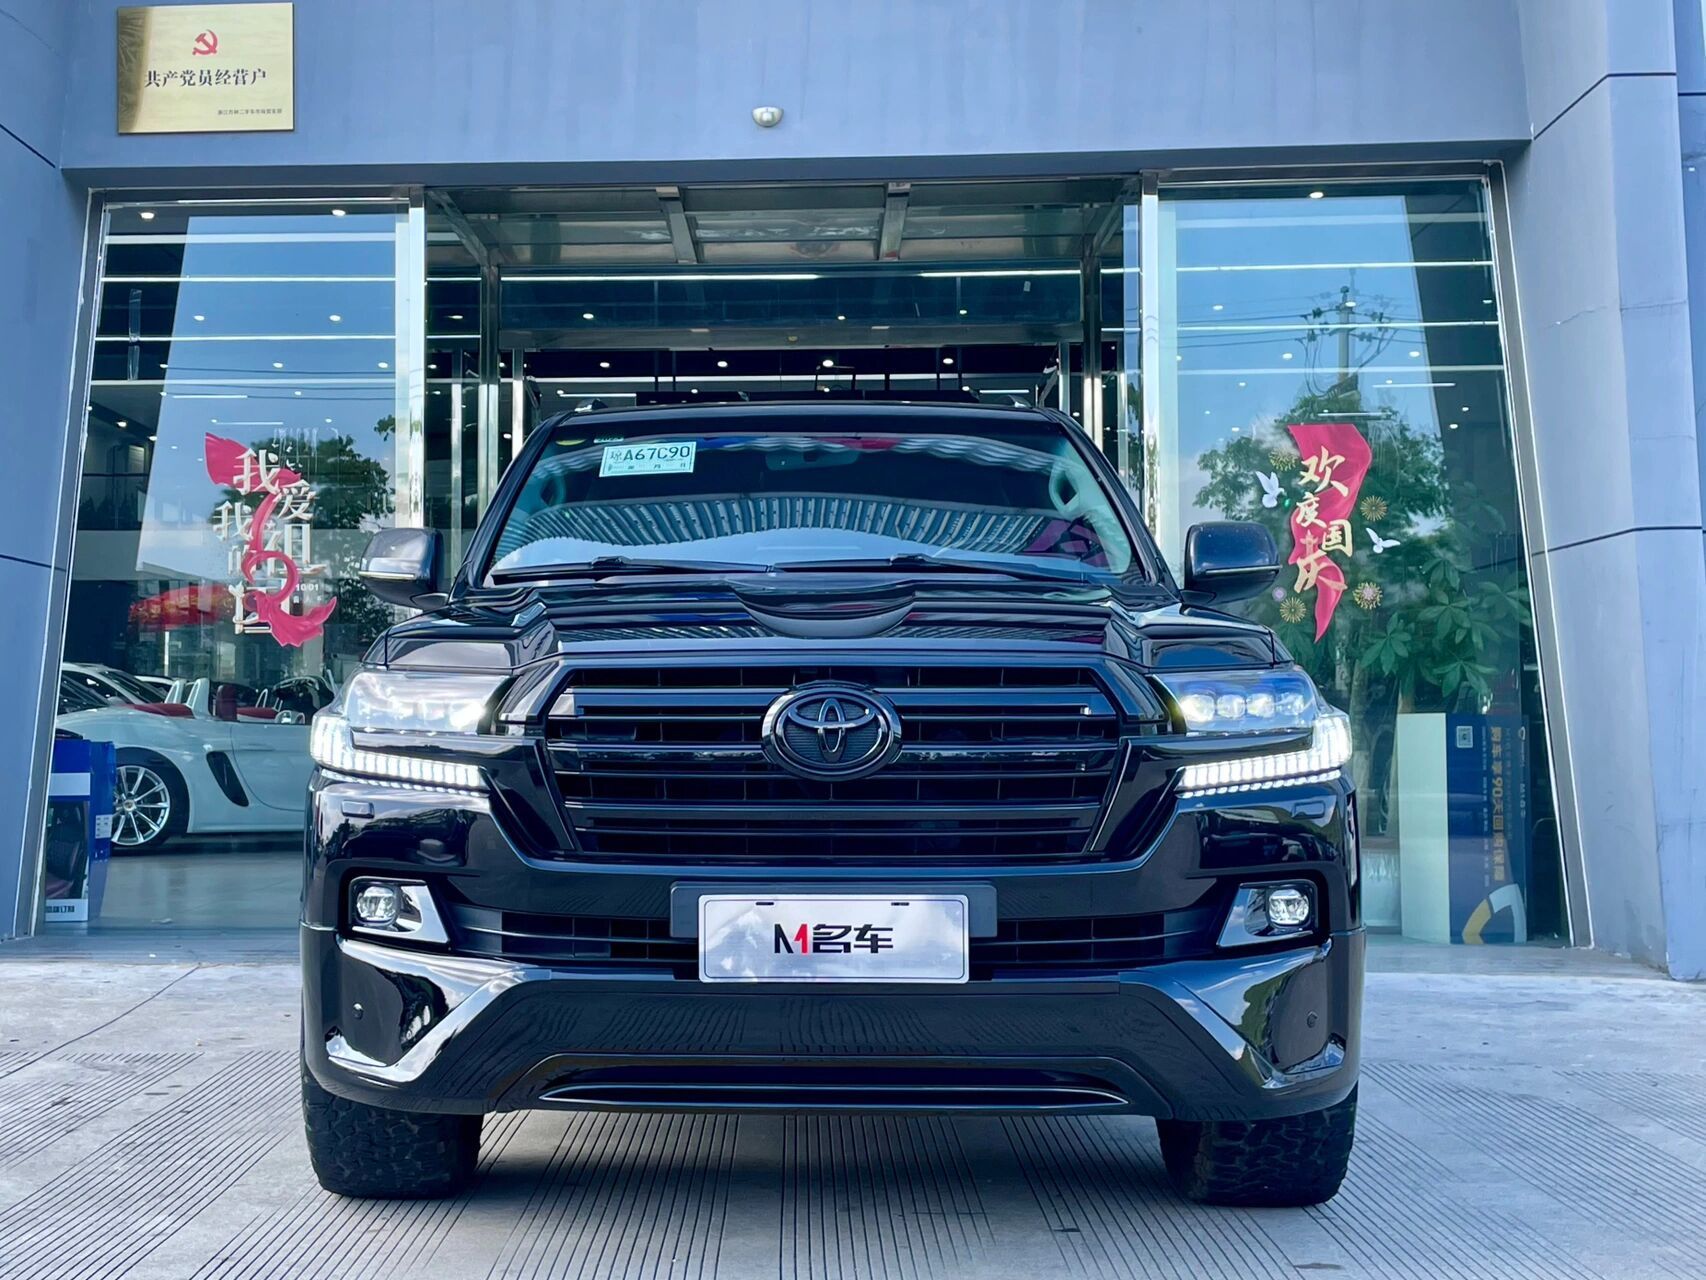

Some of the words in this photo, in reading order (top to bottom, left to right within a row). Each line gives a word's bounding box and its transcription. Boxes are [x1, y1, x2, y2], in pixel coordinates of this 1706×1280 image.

[144, 68, 267, 88] 共产党员经营户
[1293, 445, 1354, 594] 欢度国庆
[773, 923, 894, 955] M1名车
